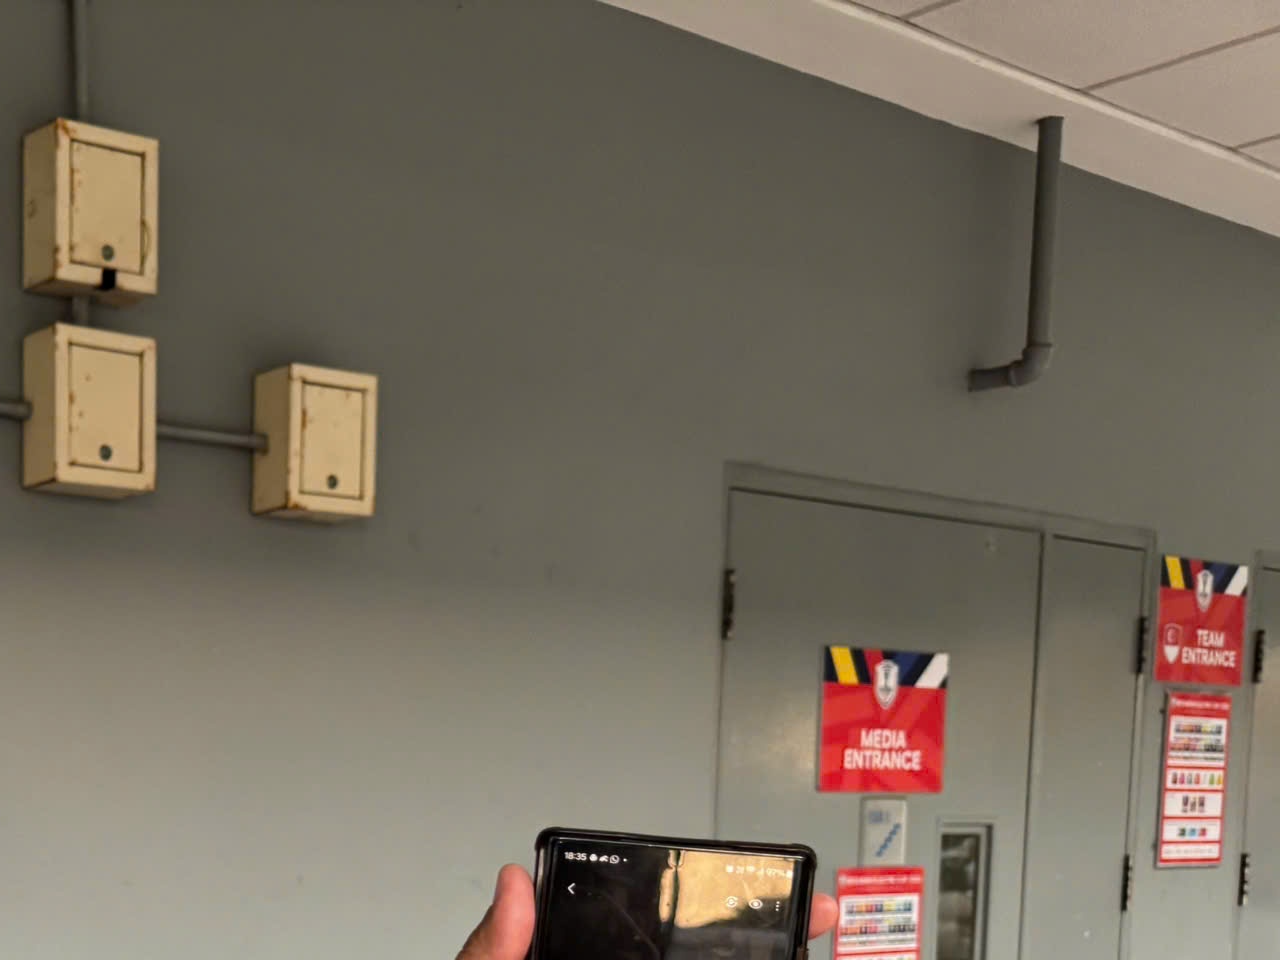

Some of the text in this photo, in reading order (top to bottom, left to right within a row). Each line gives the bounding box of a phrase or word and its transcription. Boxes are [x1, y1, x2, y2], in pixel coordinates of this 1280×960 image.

[1197, 629, 1225, 648] TEAM
[1182, 646, 1236, 668] ENTRANCE
[861, 728, 906, 749] MEDIA
[844, 748, 922, 771] ENTRANCE
[564, 851, 587, 862] 18:35
